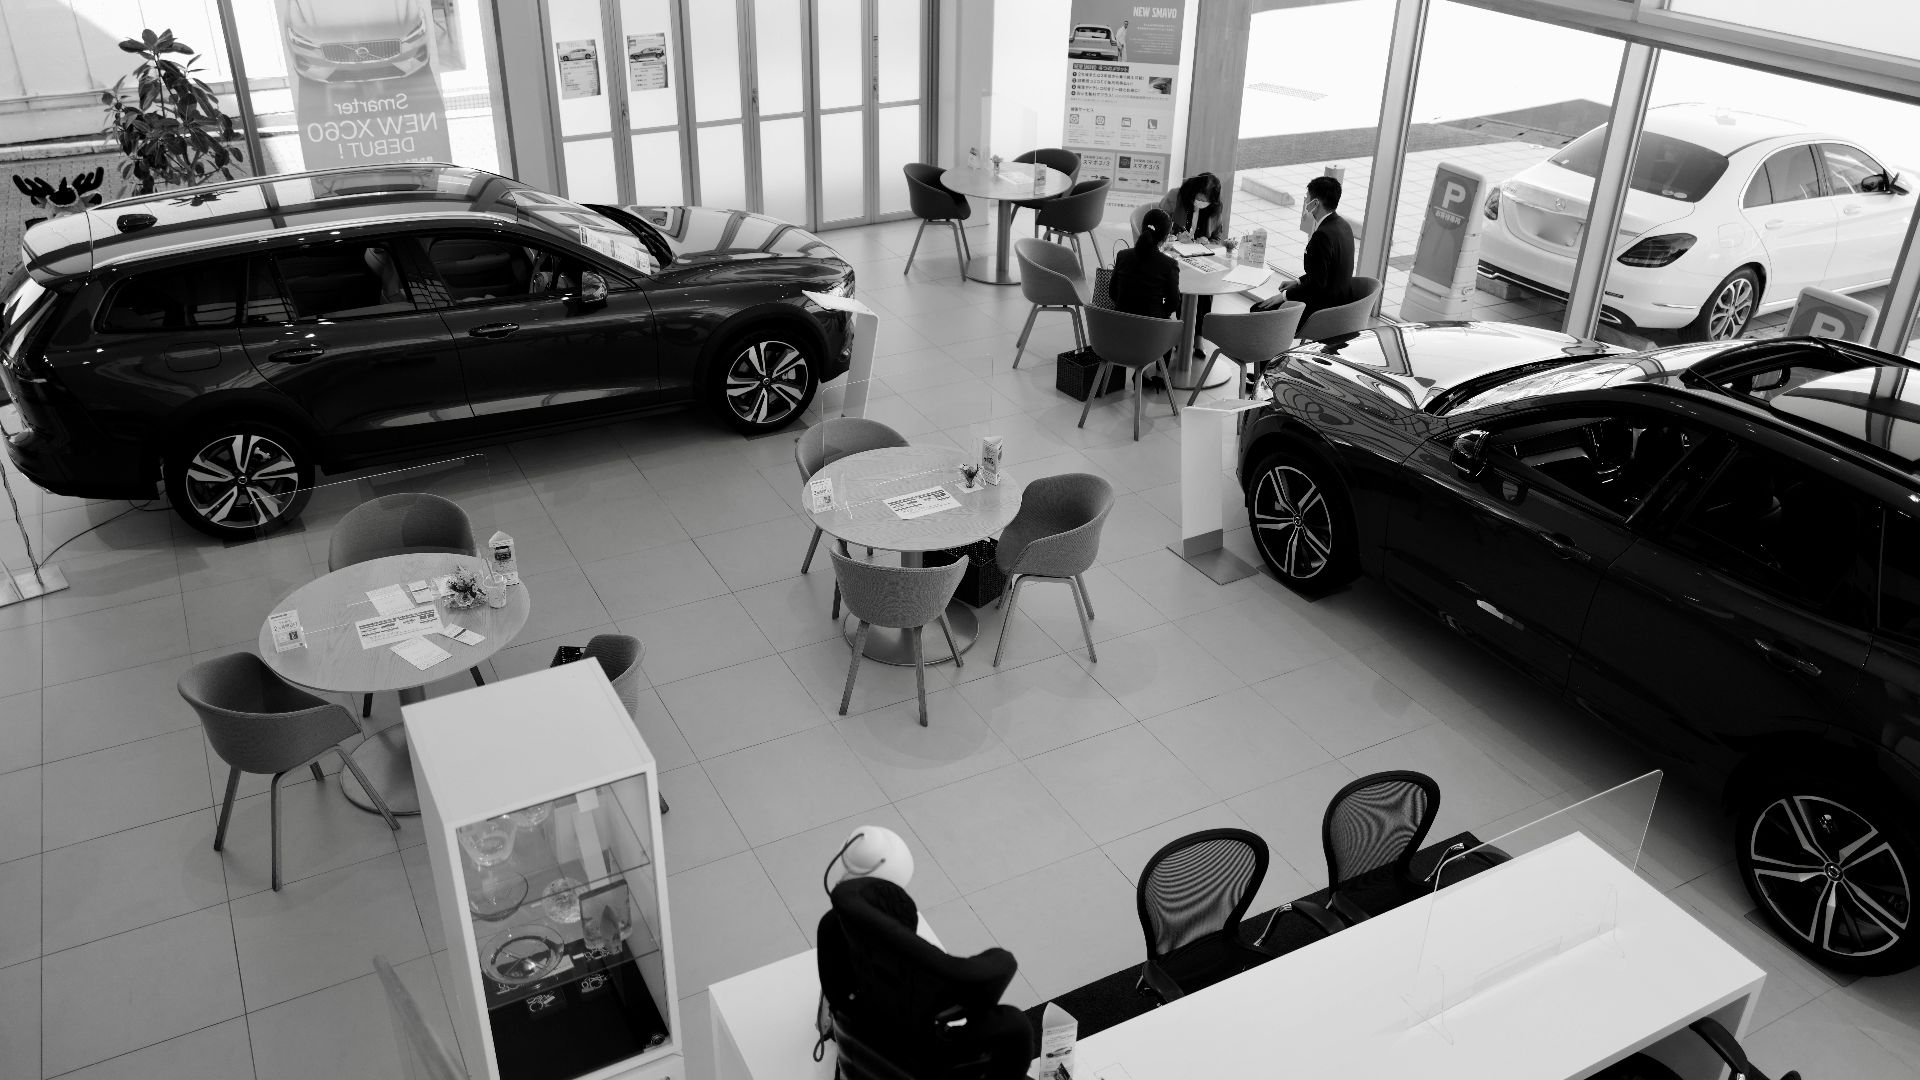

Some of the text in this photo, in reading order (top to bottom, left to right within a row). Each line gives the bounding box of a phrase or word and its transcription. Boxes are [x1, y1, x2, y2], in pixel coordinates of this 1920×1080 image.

[1133, 7, 1177, 18] NEW SMAVO
[1441, 181, 1467, 209] P
